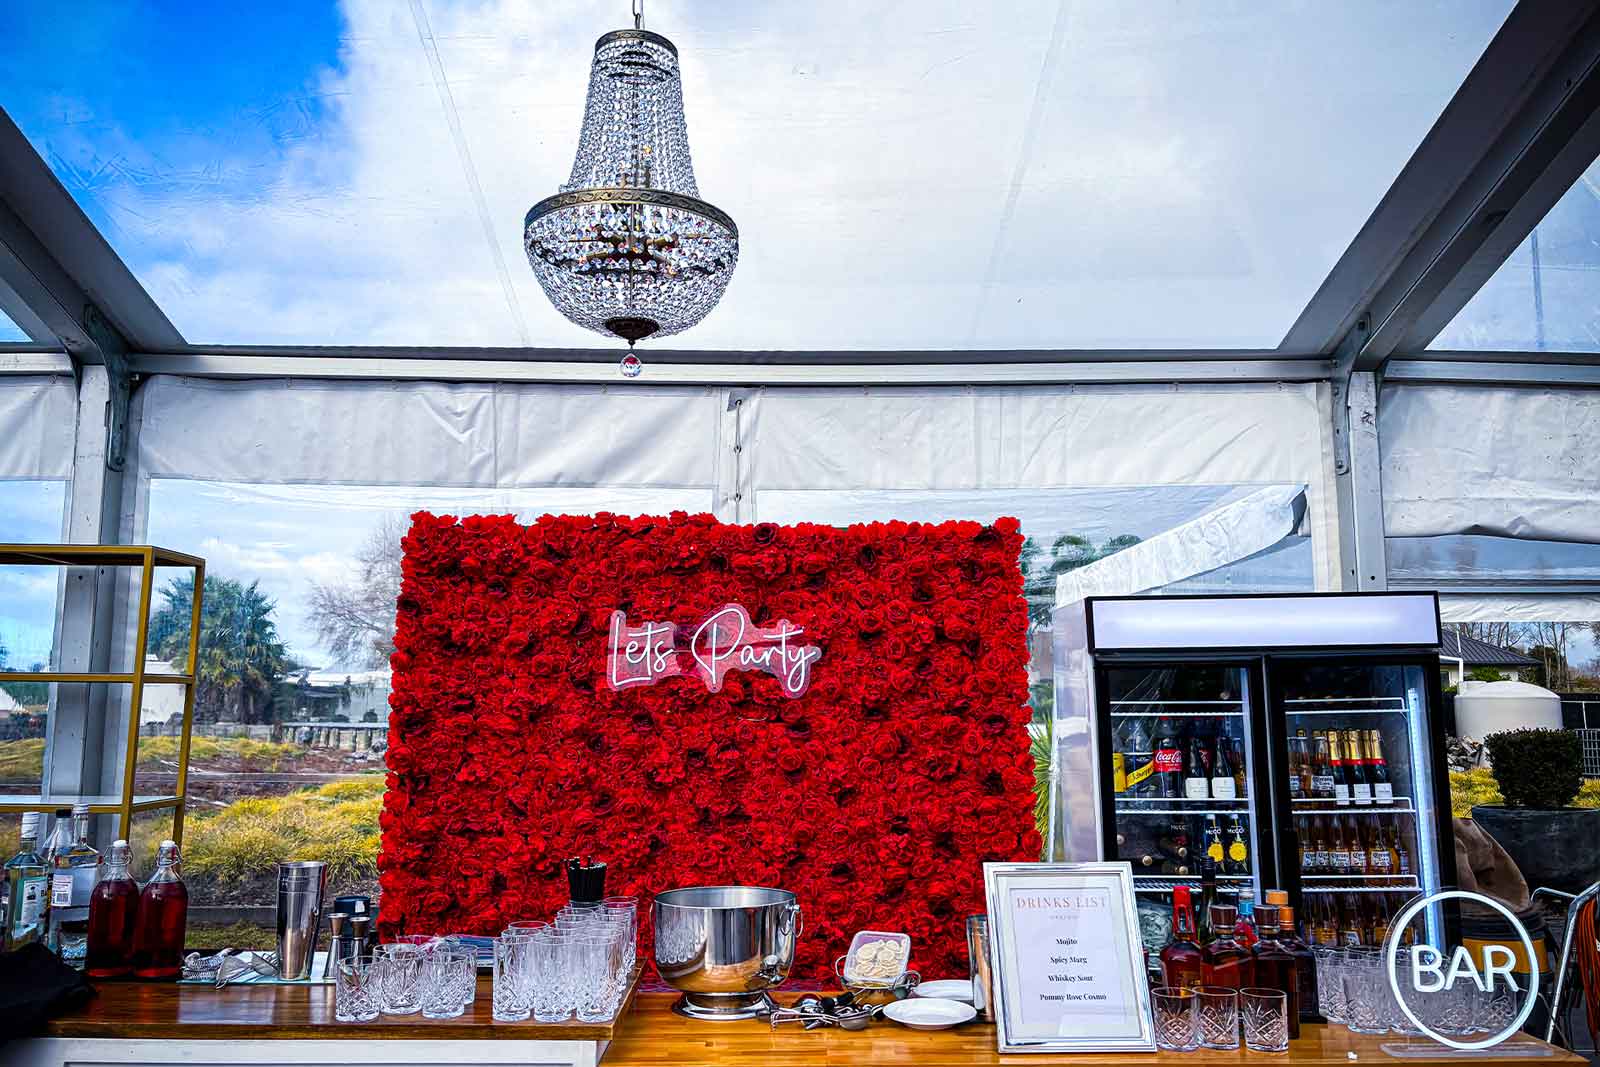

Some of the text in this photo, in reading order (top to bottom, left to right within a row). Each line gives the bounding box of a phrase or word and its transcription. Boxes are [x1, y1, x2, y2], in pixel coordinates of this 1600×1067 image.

[612, 607, 816, 693] Lets Party
[1016, 896, 1106, 909] DRINKS LIST
[1055, 937, 1079, 946] Mojito
[1050, 956, 1088, 965] Spicy Marg
[1411, 945, 1519, 993] BAR
[1048, 974, 1076, 983] Whiskey
